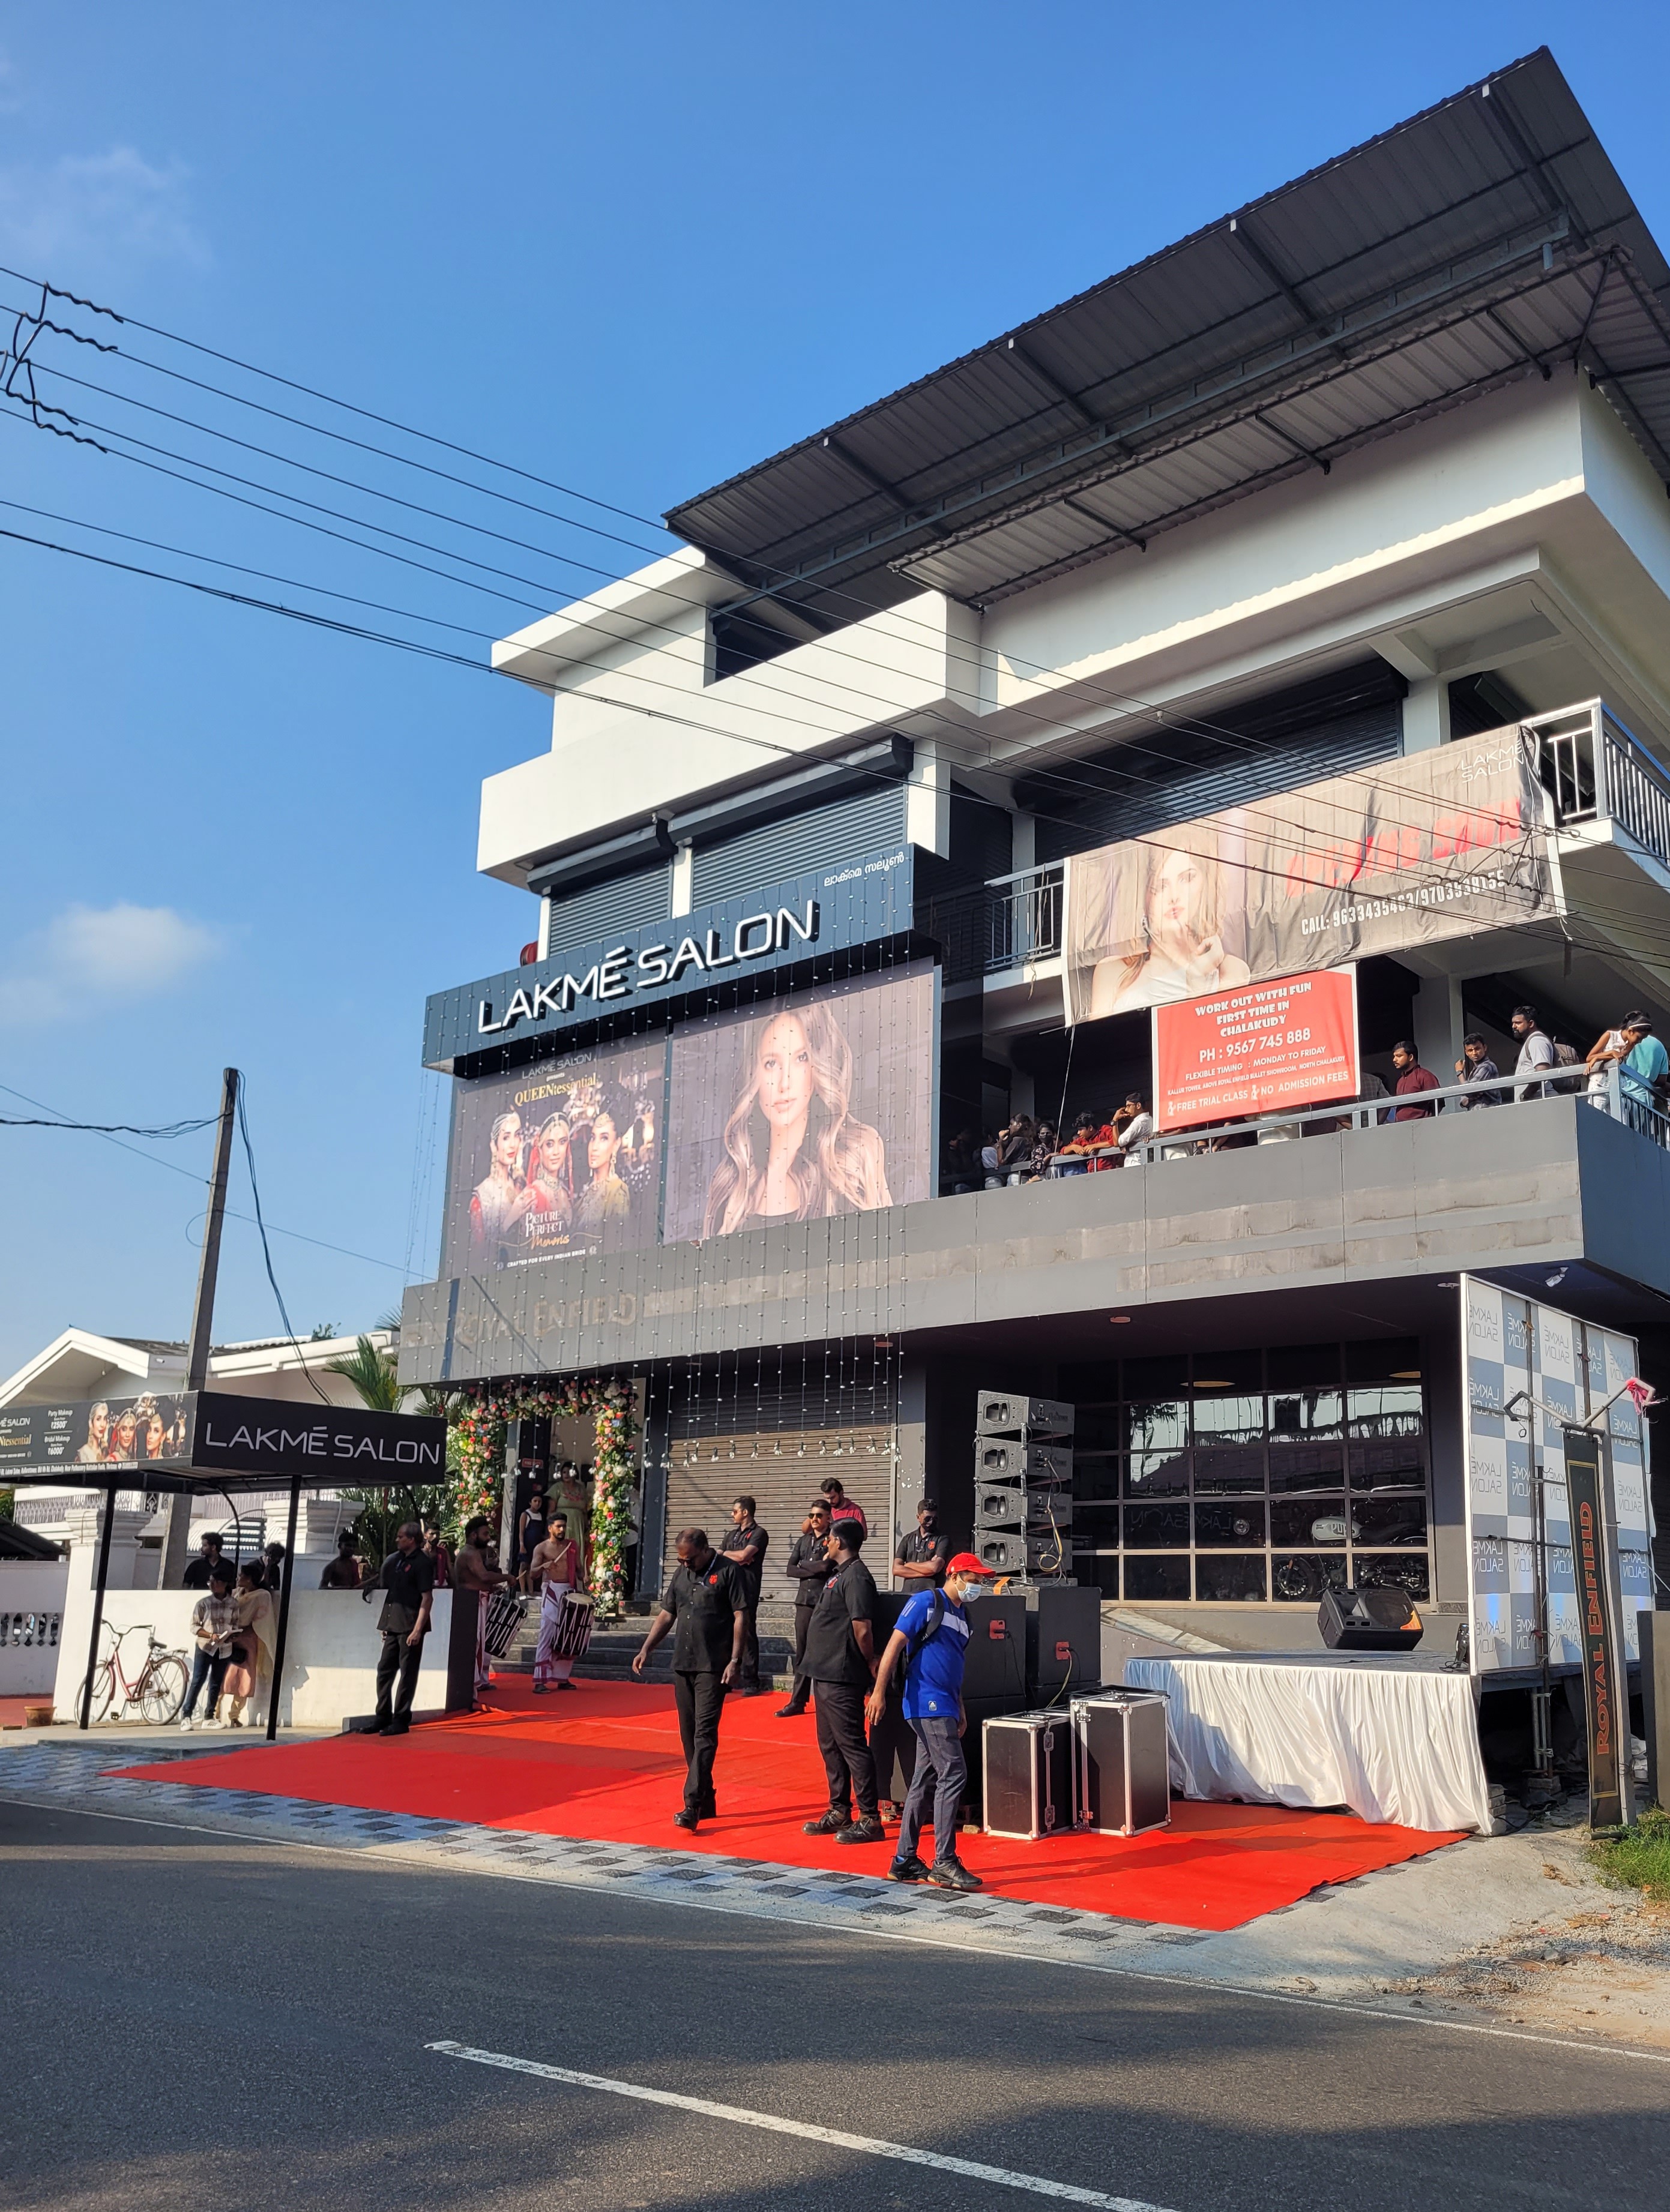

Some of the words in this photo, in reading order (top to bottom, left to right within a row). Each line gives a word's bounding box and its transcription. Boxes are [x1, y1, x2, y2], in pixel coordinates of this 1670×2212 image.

[1462, 753, 1524, 783] SALON
[1433, 797, 1520, 859] SOON
[1301, 915, 1330, 935] CALL:
[478, 946, 630, 1033] LAKMÉ
[637, 900, 816, 988] SALON
[1195, 1001, 1229, 1016] WORK
[1231, 996, 1253, 1009] OUT
[1255, 988, 1287, 1002] WITH
[1289, 982, 1312, 996] FUN
[1216, 1011, 1246, 1026] FIRST
[1248, 1005, 1276, 1019] TIME
[1277, 1000, 1289, 1011] IN
[1220, 1015, 1287, 1037] CHALAKUDY
[1199, 1047, 1216, 1063] PH
[1226, 1039, 1255, 1057] 9567
[1259, 1033, 1283, 1050] 745
[1286, 1027, 1311, 1044] 888
[522, 1060, 556, 1079] LAKMÉ
[557, 1052, 592, 1071] SALON
[1168, 1087, 1184, 1095] KALLUR
[1232, 1075, 1249, 1084] ENFIELD
[1250, 1071, 1265, 1081] BULLET
[1299, 1061, 1316, 1069] NORTH
[1316, 1056, 1345, 1066] CHALAKUDY
[1185, 1068, 1216, 1080] FLEXIBLE
[1217, 1062, 1243, 1075] TIMING
[1253, 1054, 1286, 1067] MONDAY
[1288, 1051, 1299, 1059] TO
[1301, 1046, 1326, 1057] FRIDAY
[1177, 1101, 1196, 1111] FREE
[1199, 1096, 1220, 1107] TRIAL
[1223, 1090, 1248, 1102] CLASS
[1261, 1085, 1274, 1095] NO
[1278, 1075, 1325, 1092] ADMISSION
[1327, 1071, 1348, 1082] FEES
[525, 1210, 561, 1224] PICTURE
[525, 1221, 564, 1237] PERFECT
[507, 1259, 527, 1268] CRAFTED
[554, 1251, 571, 1260] INDIAN
[571, 1249, 586, 1257] BRIDE
[7, 1417, 31, 1427] SALON
[206, 1423, 328, 1455] LAKMÉ
[333, 1435, 439, 1464] SALON
[1580, 1501, 1603, 1636] ENFIELD
[1593, 1642, 1609, 1755] ROYAL
